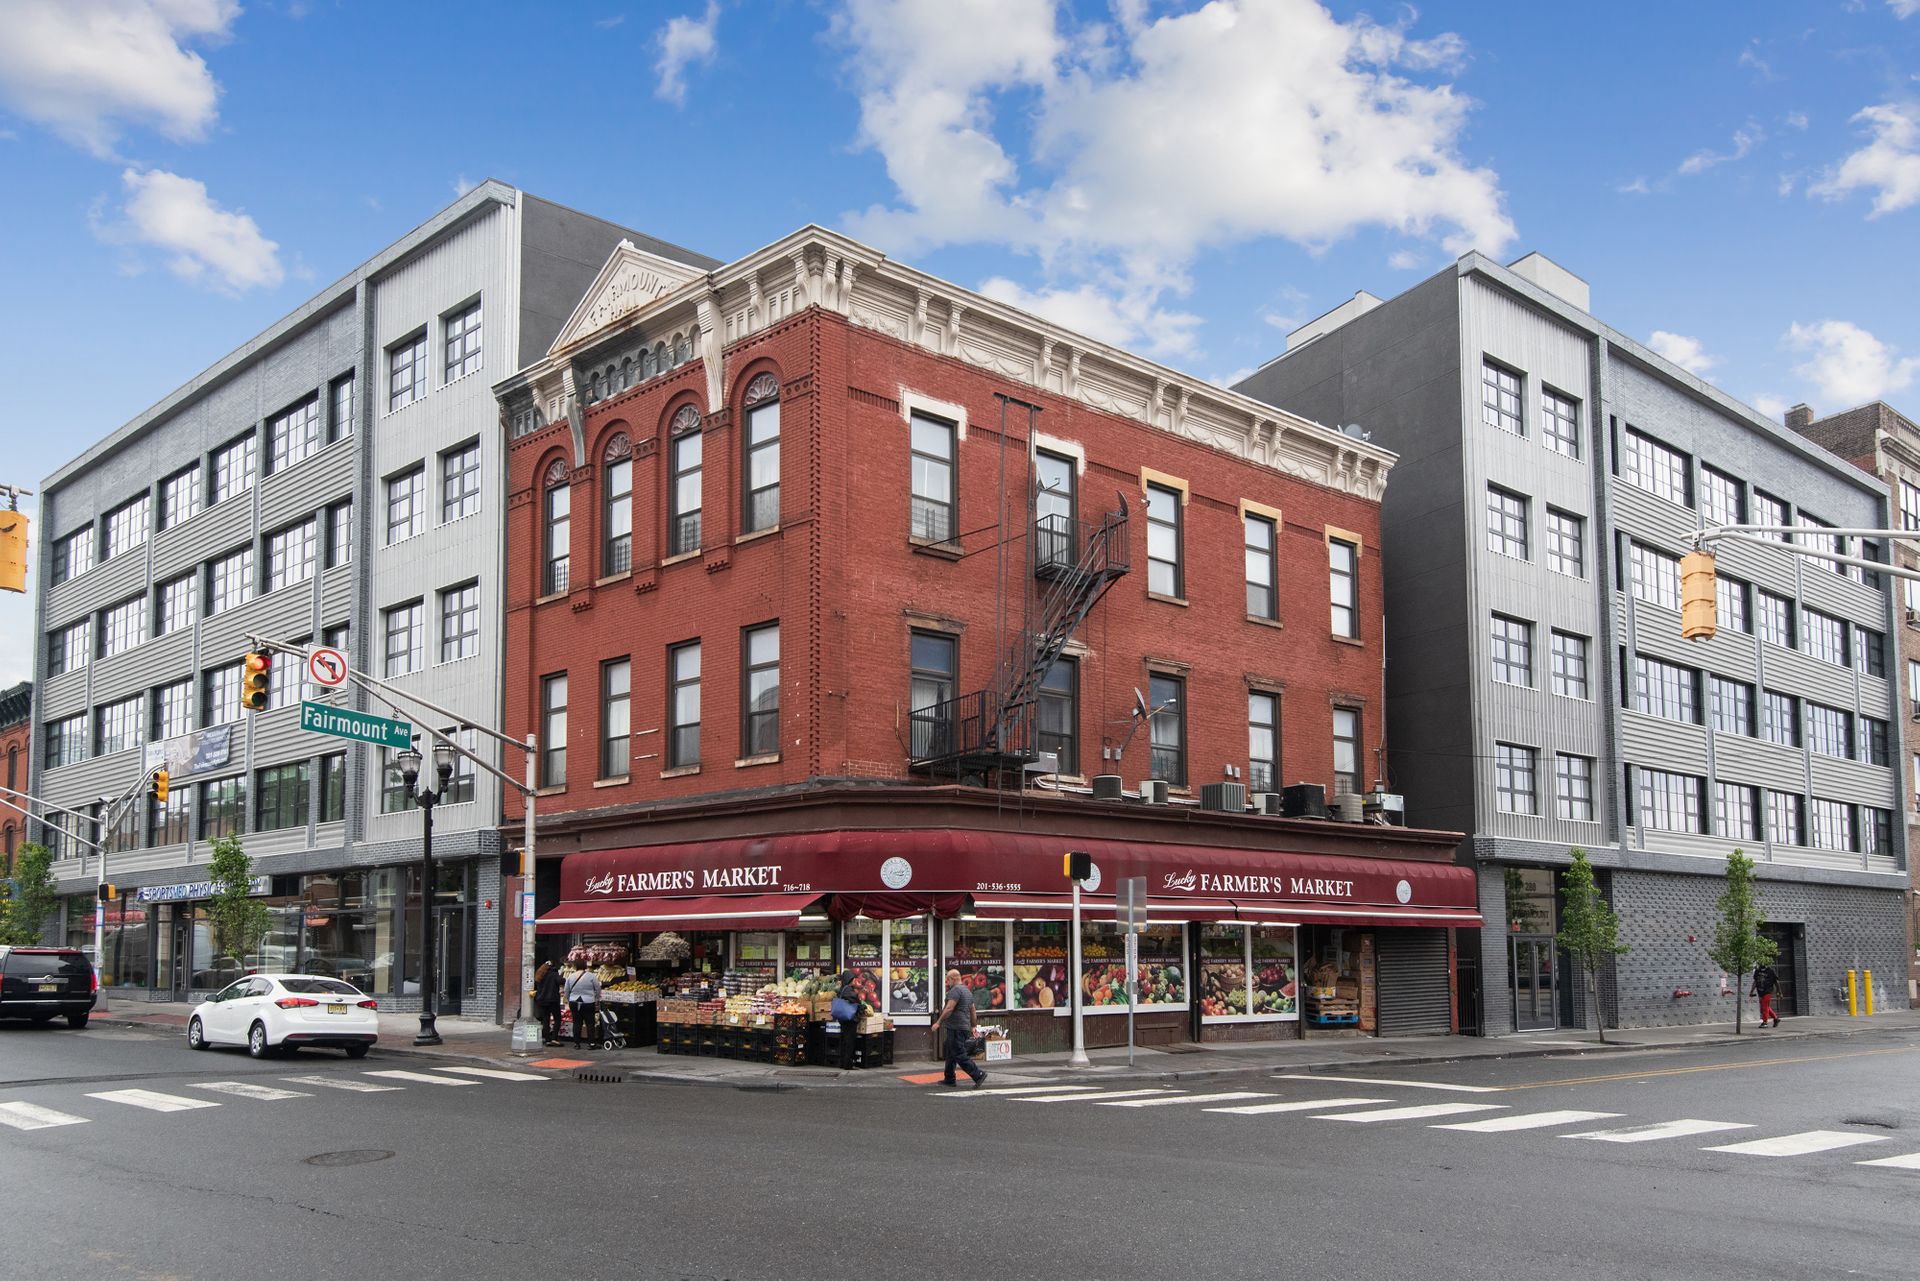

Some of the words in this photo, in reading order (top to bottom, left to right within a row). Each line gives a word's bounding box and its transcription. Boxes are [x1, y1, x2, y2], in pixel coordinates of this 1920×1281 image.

[304, 706, 388, 740] Fairmount
[394, 726, 409, 737] Ave
[584, 871, 615, 895] Lucky
[617, 870, 694, 893] FARMER'S
[702, 866, 782, 888] MARKET
[1162, 869, 1198, 892] Lucky
[1200, 874, 1282, 894] FARMER'S
[1290, 877, 1353, 897] MARKET
